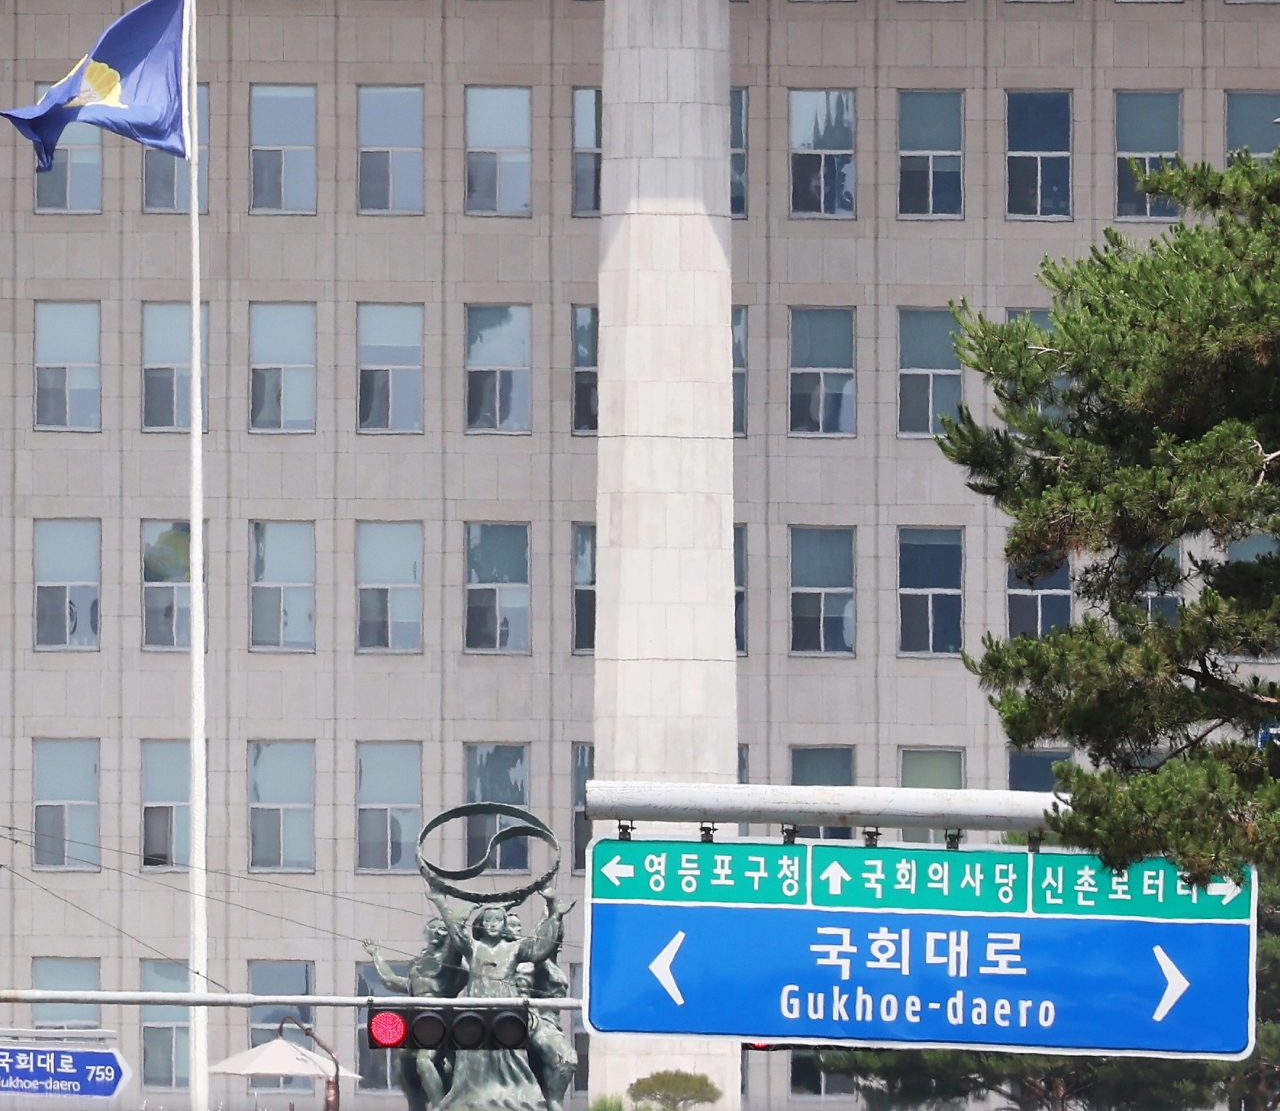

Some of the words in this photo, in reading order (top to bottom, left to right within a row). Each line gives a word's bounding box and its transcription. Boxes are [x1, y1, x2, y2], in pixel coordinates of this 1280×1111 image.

[644, 852, 800, 897] 영등포구청
[861, 858, 1017, 904] 국회의사당
[809, 926, 1027, 980] 국회대로
[780, 984, 1056, 1028] Gukhoe-daero
[86, 1065, 115, 1082] 759
